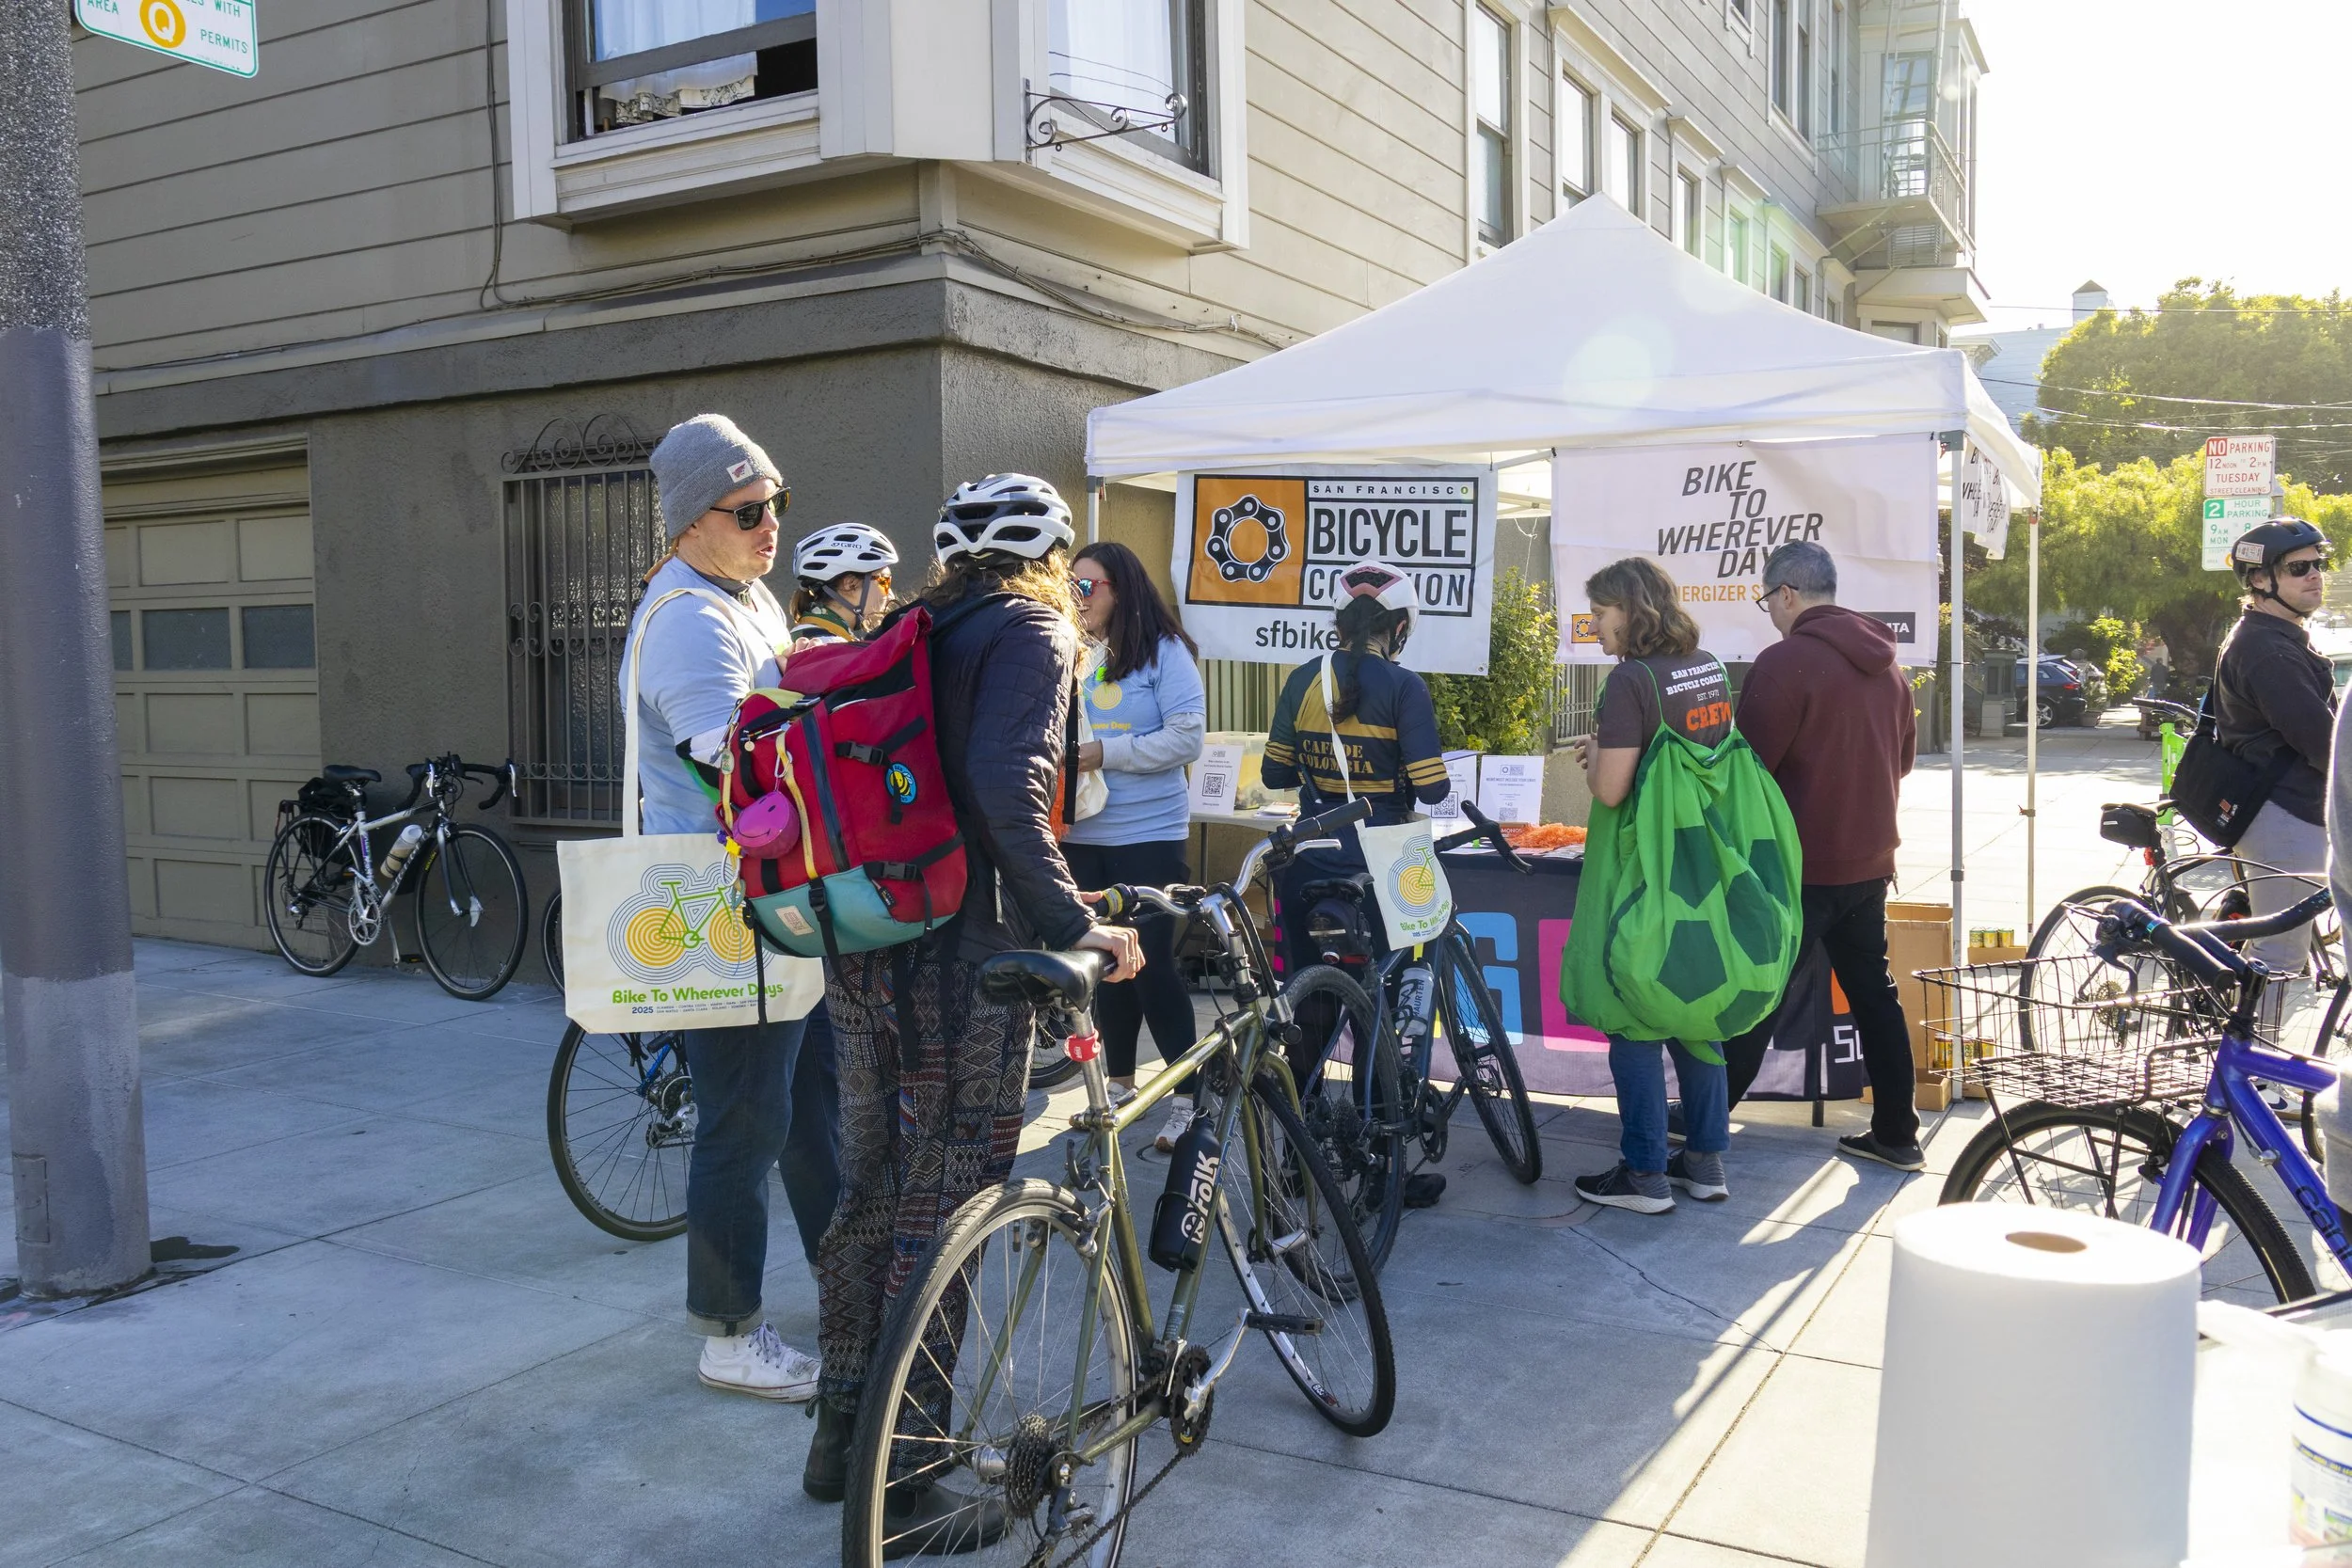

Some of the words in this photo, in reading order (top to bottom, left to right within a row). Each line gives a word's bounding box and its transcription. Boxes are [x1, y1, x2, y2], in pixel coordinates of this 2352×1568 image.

[149, 2, 176, 42] Q
[200, 28, 248, 54] PERMITS
[2208, 439, 2227, 455] NO
[2230, 441, 2270, 453] PARKING
[2210, 458, 2221, 469] 12
[2249, 457, 2257, 467] 2
[1682, 460, 1756, 497] BIKE
[2216, 472, 2260, 483] TUESDAY
[1313, 485, 1344, 494] SAN
[1356, 485, 1469, 495] FRANCISCO
[1729, 488, 1767, 520] TO
[2208, 502, 2221, 517] 2
[2234, 499, 2261, 508] HOUR
[2227, 509, 2267, 518] PARKING
[1312, 508, 1467, 558] BICYCLE
[1658, 513, 1823, 556] WHEREVER
[2211, 524, 2217, 534] 9
[1677, 584, 1747, 602] ERGIZER
[1255, 621, 1341, 650] sfbike
[1671, 669, 1689, 680] SAN
[1665, 679, 1700, 696] BICYCLE
[1686, 701, 1732, 732] CREW
[1343, 743, 1363, 758] DE
[612, 990, 647, 1005] Bike
[651, 989, 669, 1003] To
[672, 986, 744, 1002] Wherever
[748, 983, 784, 998] Dys
[631, 1006, 654, 1015] 2025
